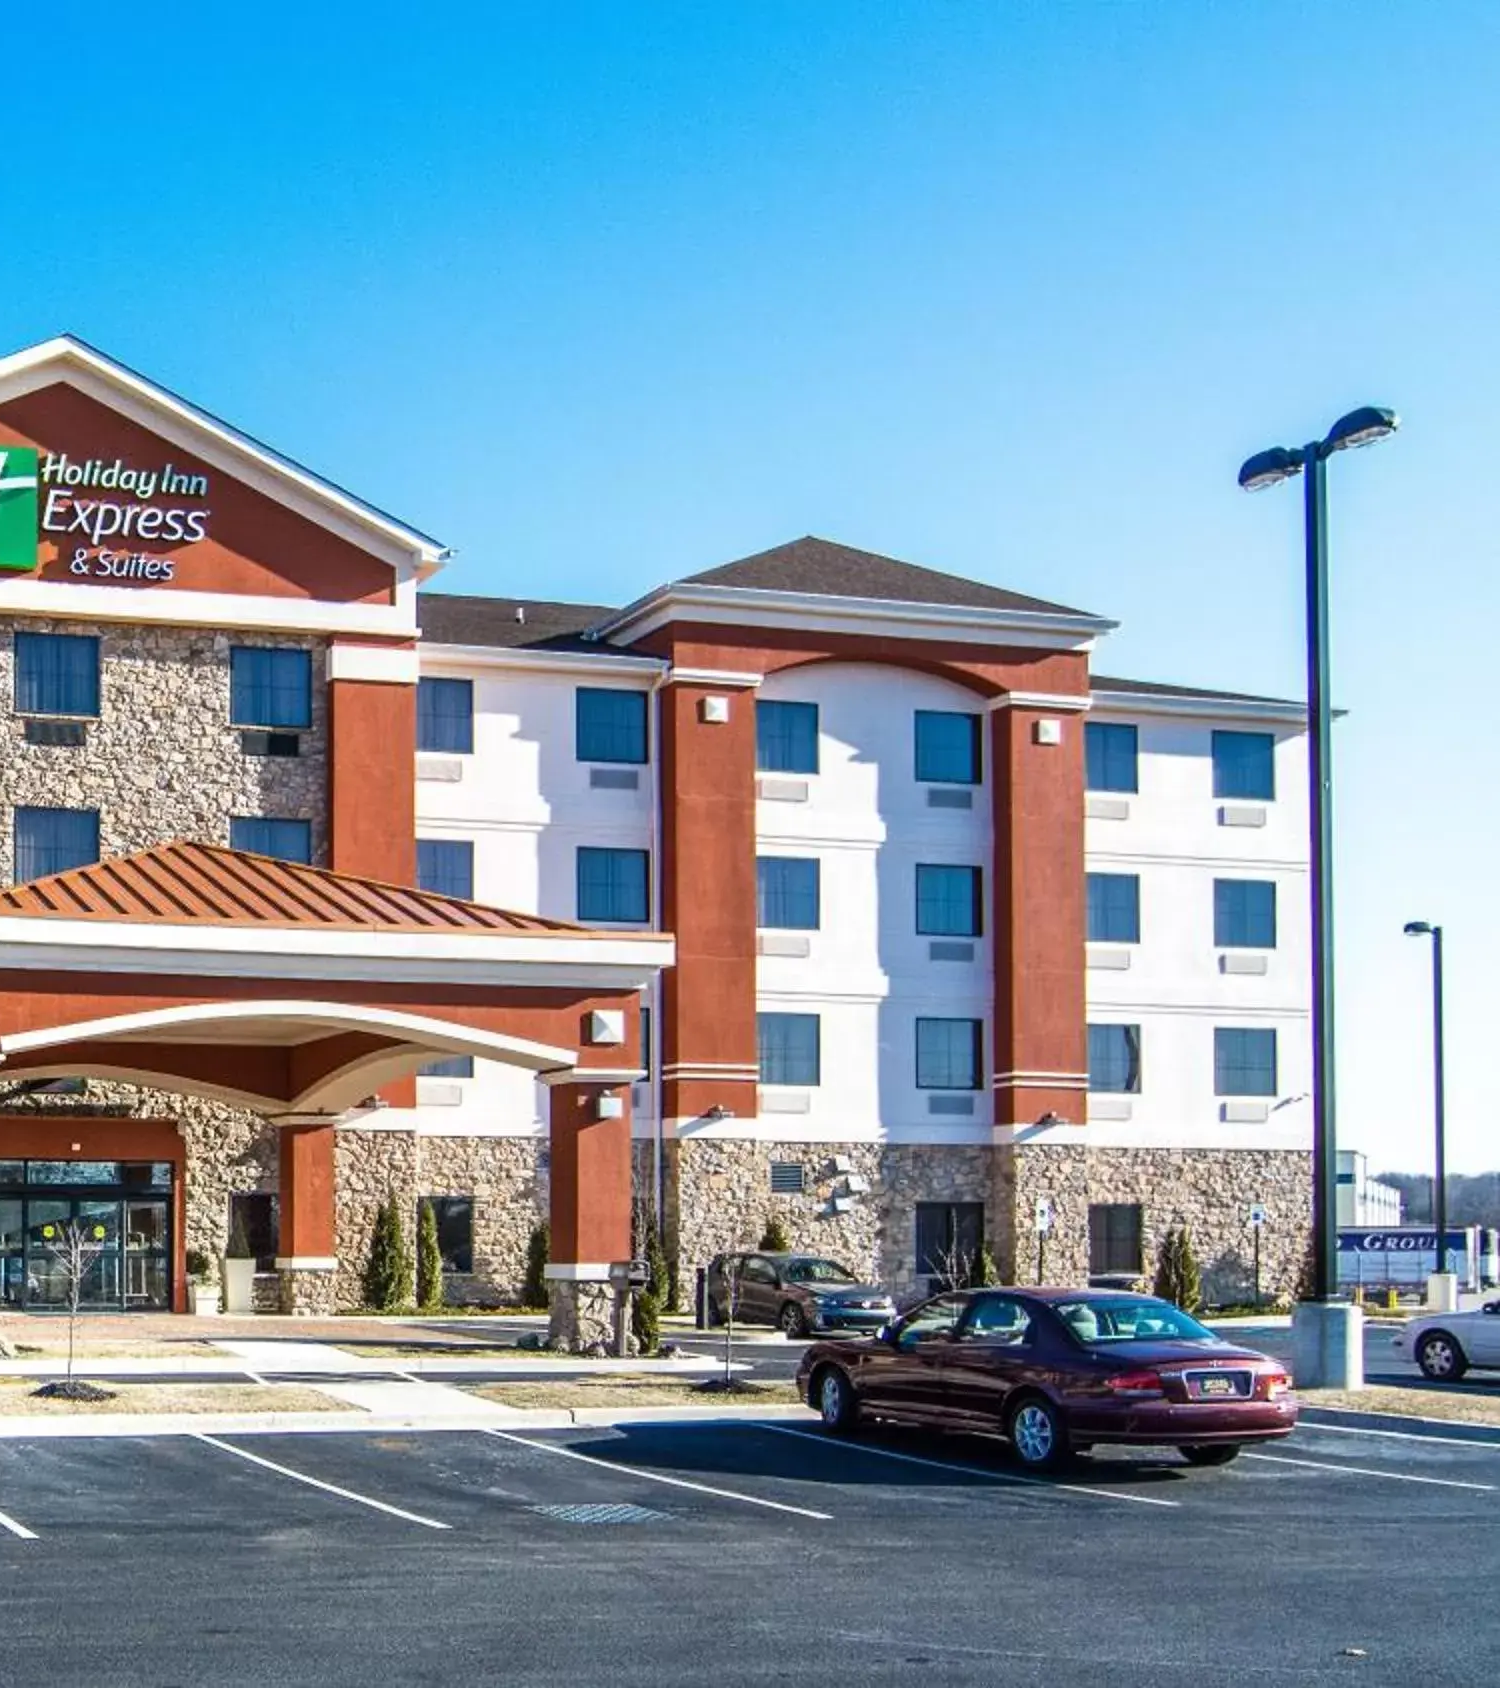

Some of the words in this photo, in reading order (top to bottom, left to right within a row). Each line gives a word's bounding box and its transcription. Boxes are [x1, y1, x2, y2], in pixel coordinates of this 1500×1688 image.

[42, 452, 157, 498] Holiday
[161, 464, 207, 496] Inn
[42, 489, 207, 545] Express
[70, 548, 90, 575] &
[96, 549, 174, 581] Suites
